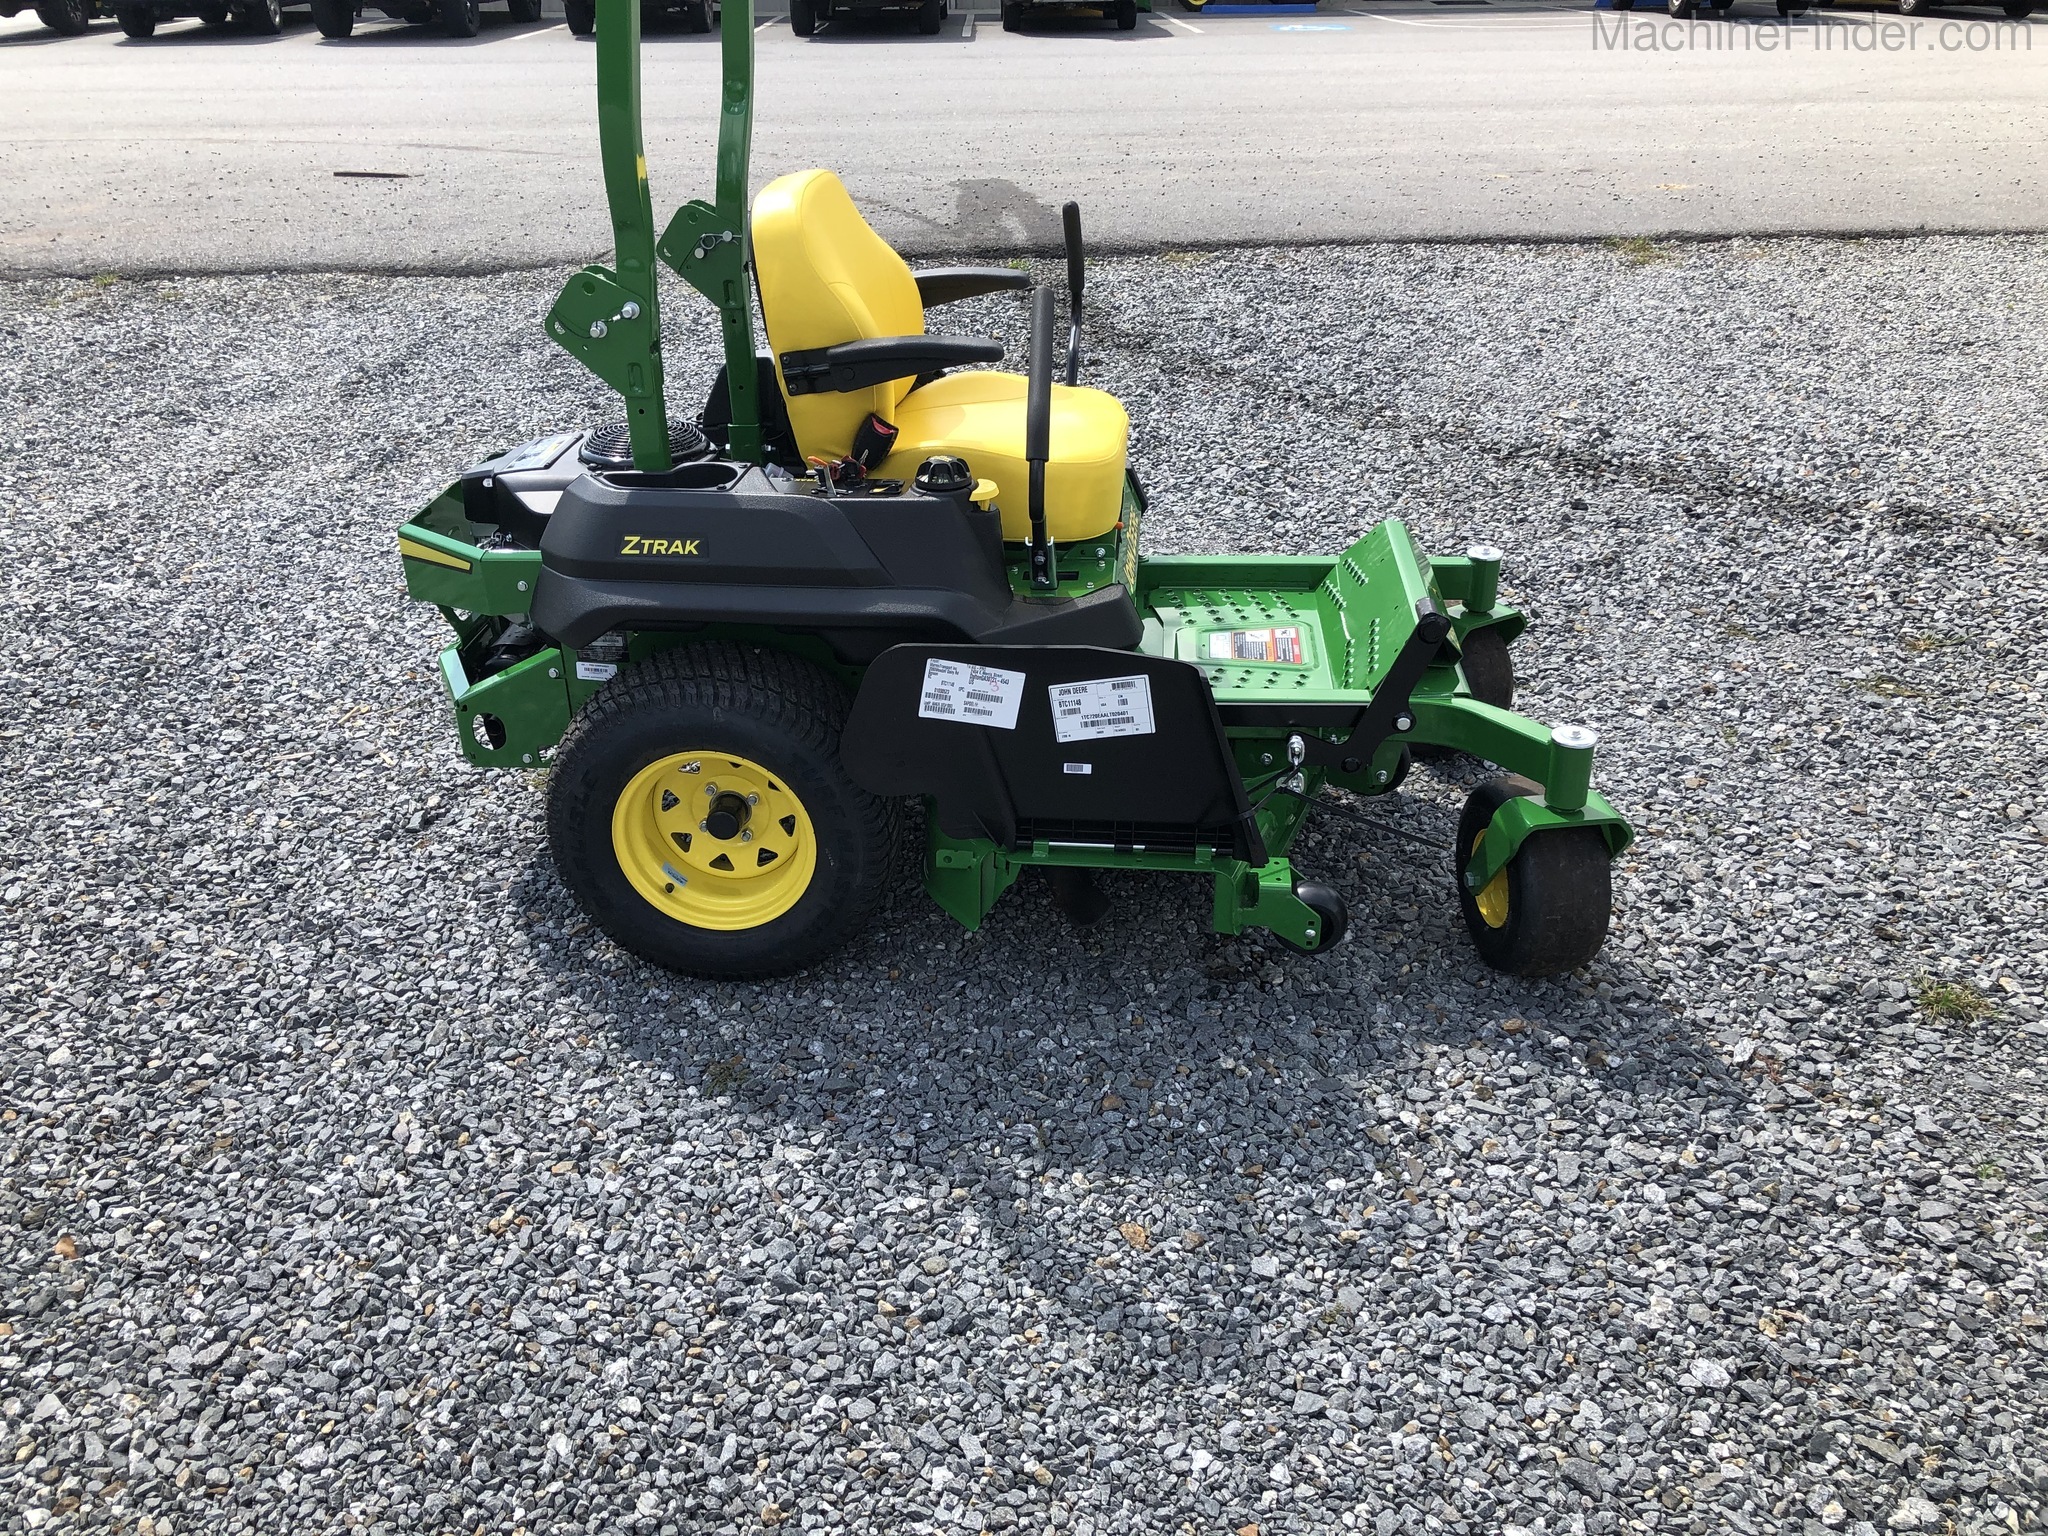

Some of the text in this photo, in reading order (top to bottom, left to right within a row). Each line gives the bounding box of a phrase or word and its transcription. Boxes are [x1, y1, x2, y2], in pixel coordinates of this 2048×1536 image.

[621, 536, 701, 555] ZTRAK
[1058, 686, 1088, 696] JOHN DEERE
